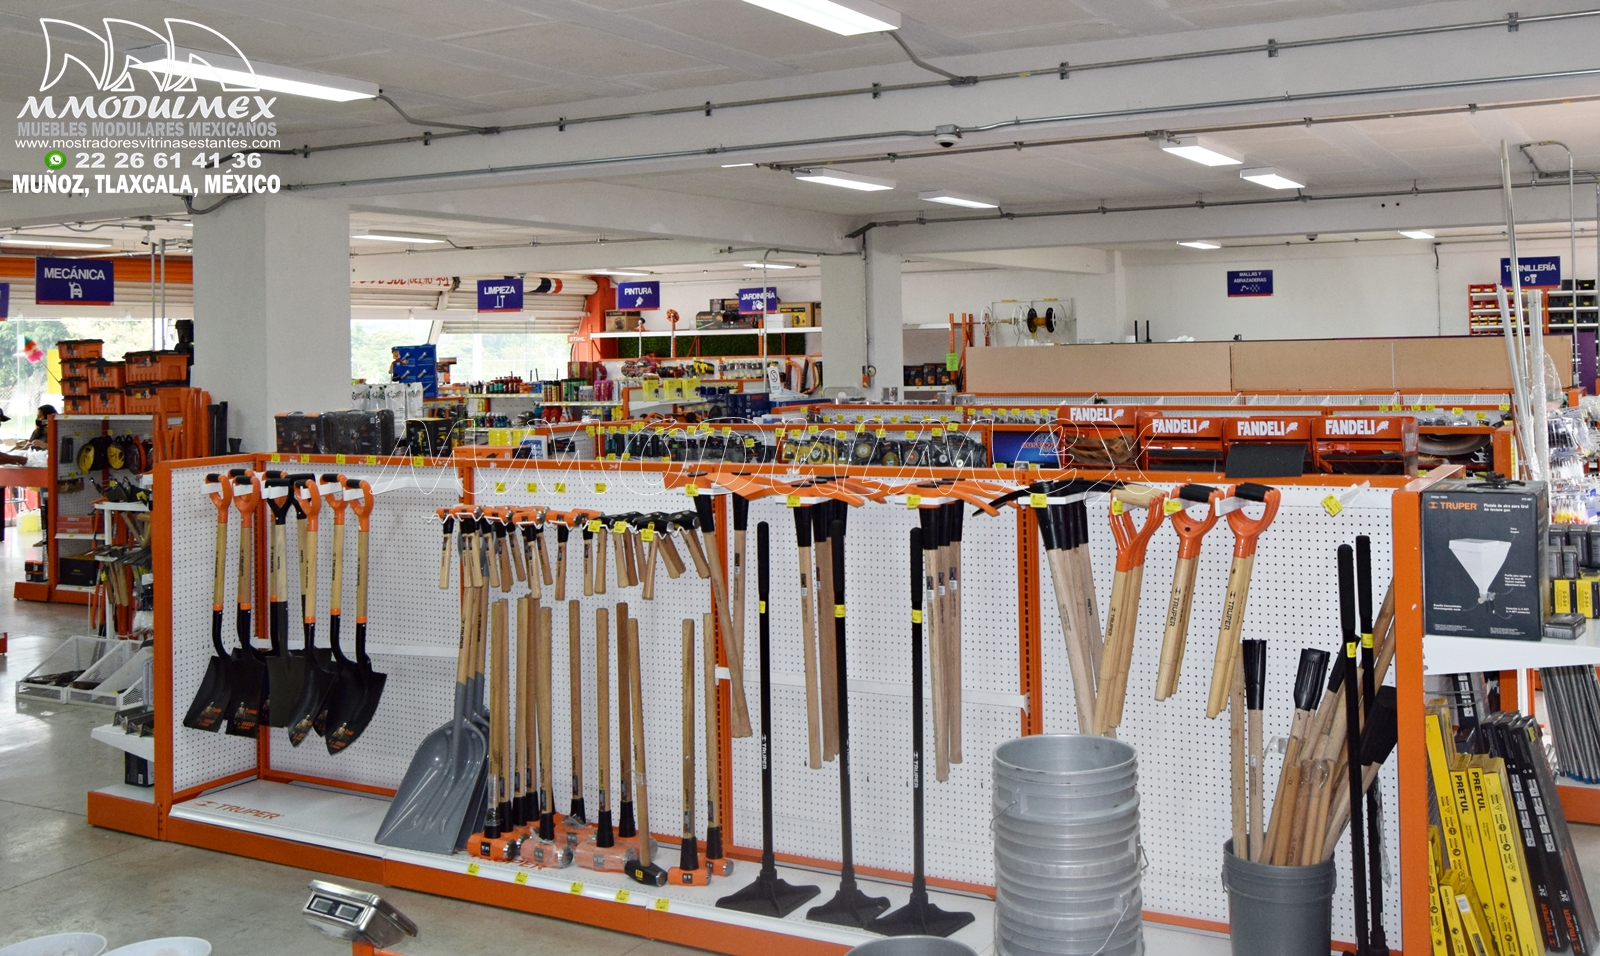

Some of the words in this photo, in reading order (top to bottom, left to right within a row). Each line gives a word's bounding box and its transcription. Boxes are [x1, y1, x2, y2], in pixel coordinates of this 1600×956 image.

[44, 266, 105, 281] MECÁNICA
[484, 285, 516, 295] LIMPIEZA
[624, 287, 652, 296] PINTURA
[741, 290, 775, 301] JARDINERÍA
[1070, 407, 1113, 422] FANDELI
[1152, 418, 1198, 434] FANDELI
[1237, 420, 1285, 436] FANDELI
[1325, 419, 1376, 435] FANDELI
[1440, 502, 1478, 511] TRUPER
[1169, 597, 1180, 627] TRUPER
[1224, 601, 1235, 631] TRUPER
[1454, 775, 1469, 814] PRETUL
[1472, 772, 1486, 811] PRETUL
[216, 804, 281, 820] TRUPER
[1559, 890, 1570, 902] 24"
[1541, 903, 1554, 936] TRUPER
[1563, 908, 1578, 942] TRUPER
